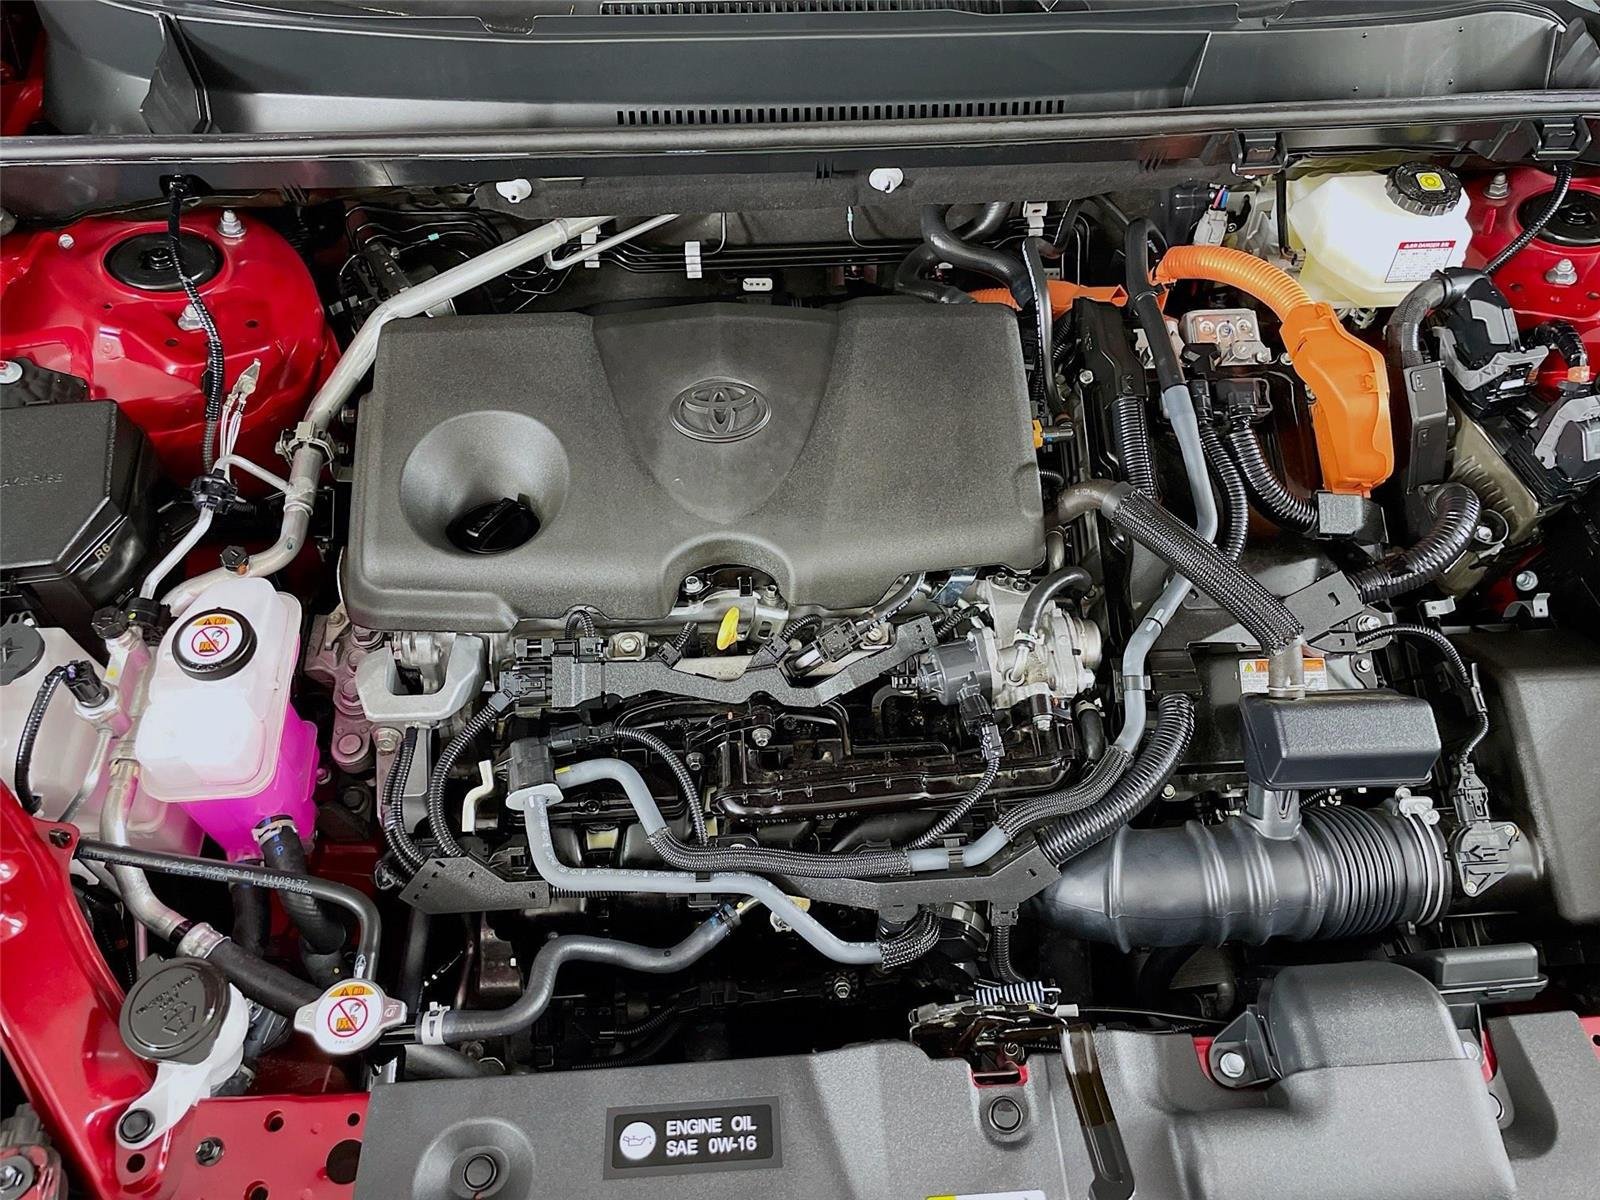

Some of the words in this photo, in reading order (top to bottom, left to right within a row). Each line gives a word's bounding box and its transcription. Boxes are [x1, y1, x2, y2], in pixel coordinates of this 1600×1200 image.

[94, 543, 111, 561] R6
[666, 1117, 722, 1136] ENGINE
[731, 1116, 757, 1132] OIL
[666, 1138, 698, 1156] SAE
[708, 1135, 757, 1154] 0W-16
